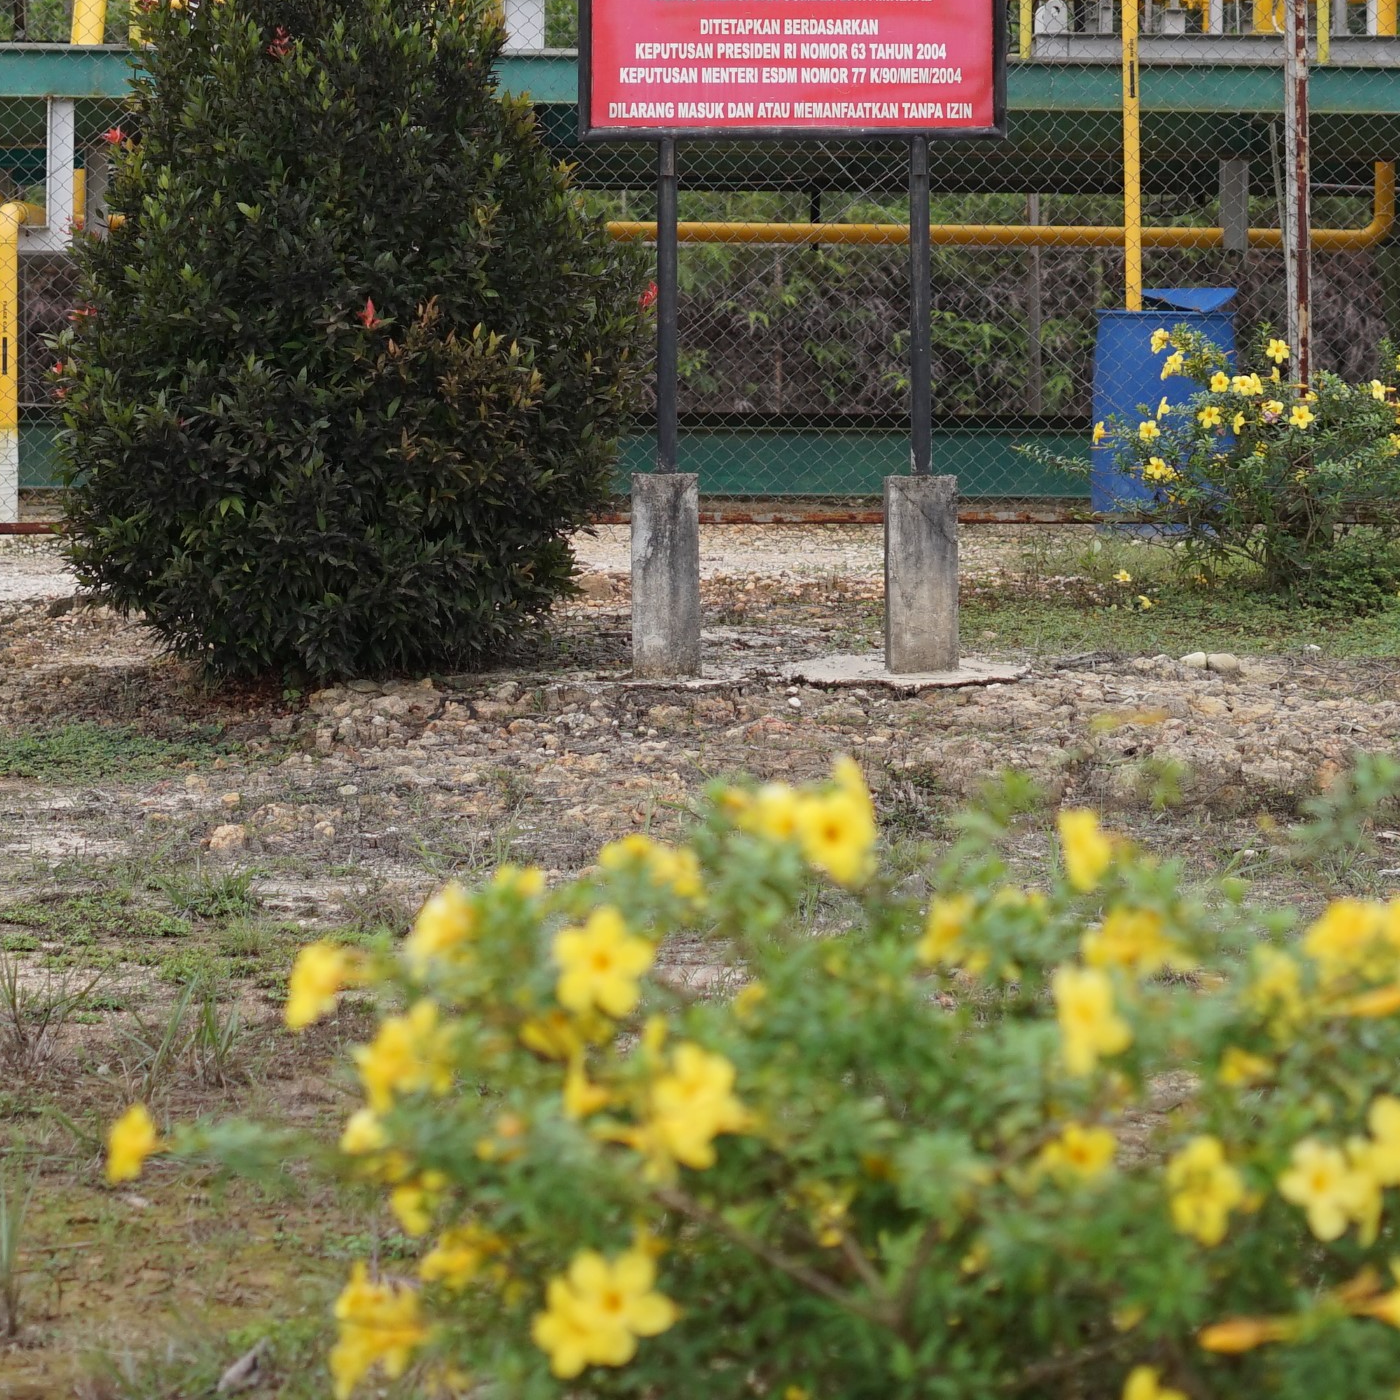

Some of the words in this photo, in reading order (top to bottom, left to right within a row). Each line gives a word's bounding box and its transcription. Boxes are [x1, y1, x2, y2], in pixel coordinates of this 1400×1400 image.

[700, 18, 781, 35] DITETAPKAN
[783, 18, 879, 36] BERDASARKAN
[635, 42, 714, 60] KEPUTUSAN
[716, 42, 781, 60] PRESIDEN
[783, 42, 797, 59] RI
[800, 42, 849, 60] NOMOR
[850, 42, 867, 60] 63
[868, 43, 914, 60] TAHUN
[916, 42, 947, 60] 2004
[619, 66, 698, 84] KEPUTUSAN
[701, 67, 759, 84] MENTERI
[761, 66, 798, 84] ESDM
[800, 67, 849, 84] NOMOR
[851, 67, 867, 84] 77
[869, 67, 962, 84] K/90/MEM/2004
[608, 101, 675, 119] DILARANG
[677, 102, 725, 119] MASUK
[727, 102, 754, 119] DAN
[756, 102, 791, 119] ATAU
[793, 102, 899, 119] MEMANFAATKAN
[901, 102, 944, 119] TANPA
[946, 102, 973, 119] IZIN
